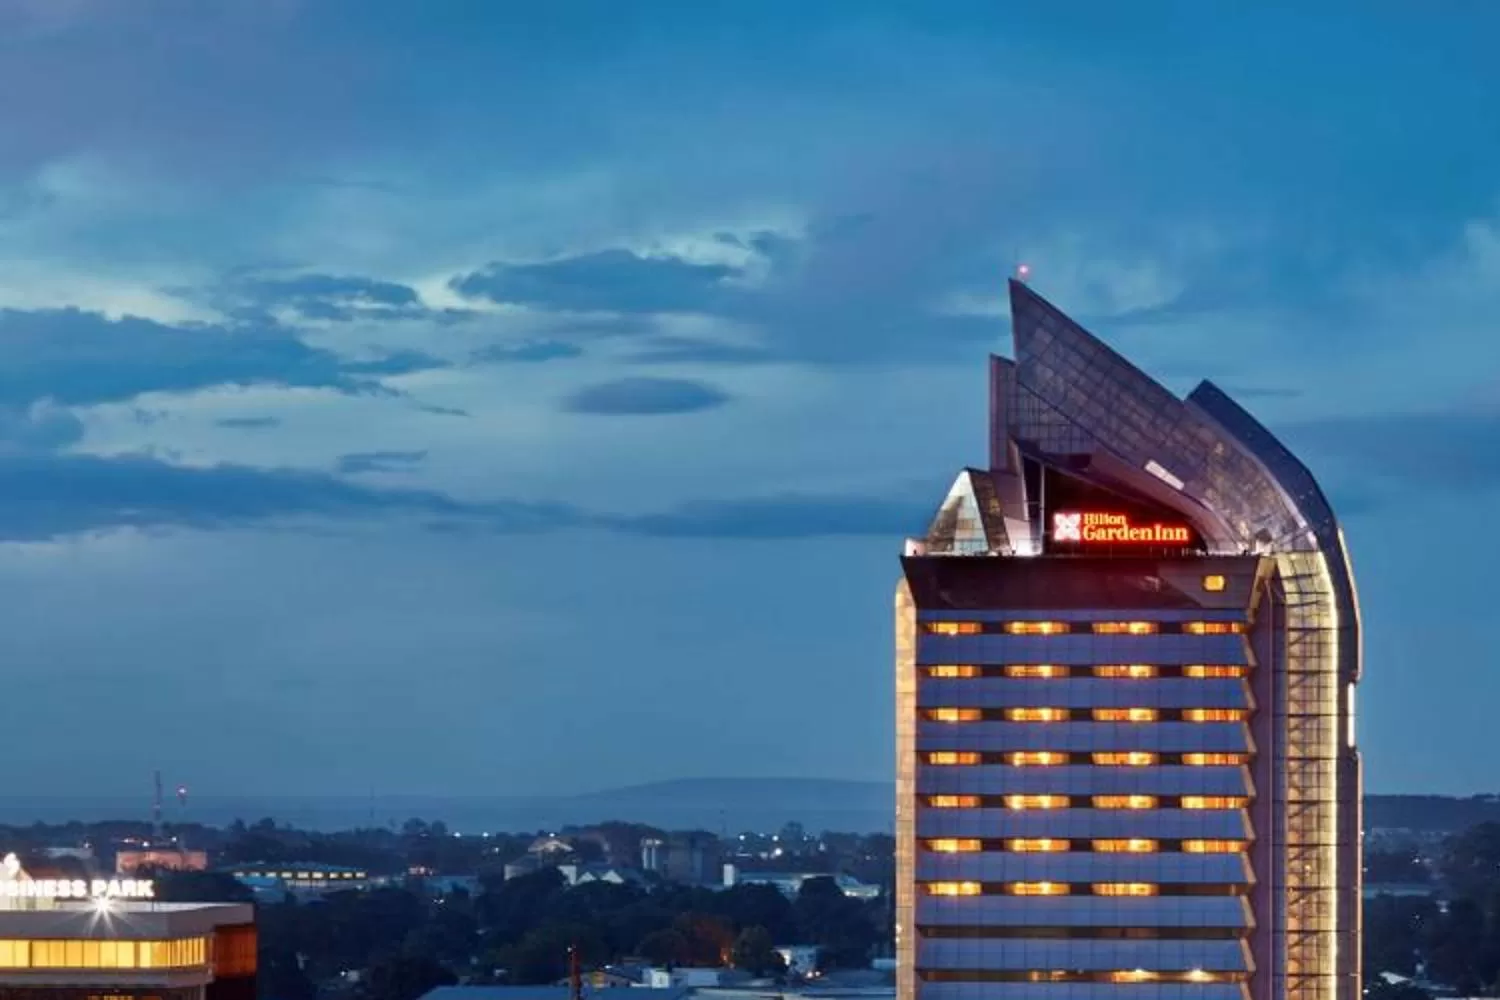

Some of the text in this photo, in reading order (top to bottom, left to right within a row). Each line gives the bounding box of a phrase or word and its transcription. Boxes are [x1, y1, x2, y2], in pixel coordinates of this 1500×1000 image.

[1083, 512, 1126, 525] Hilton
[1083, 523, 1188, 541] Garden Inn
[91, 879, 155, 897] PARK
